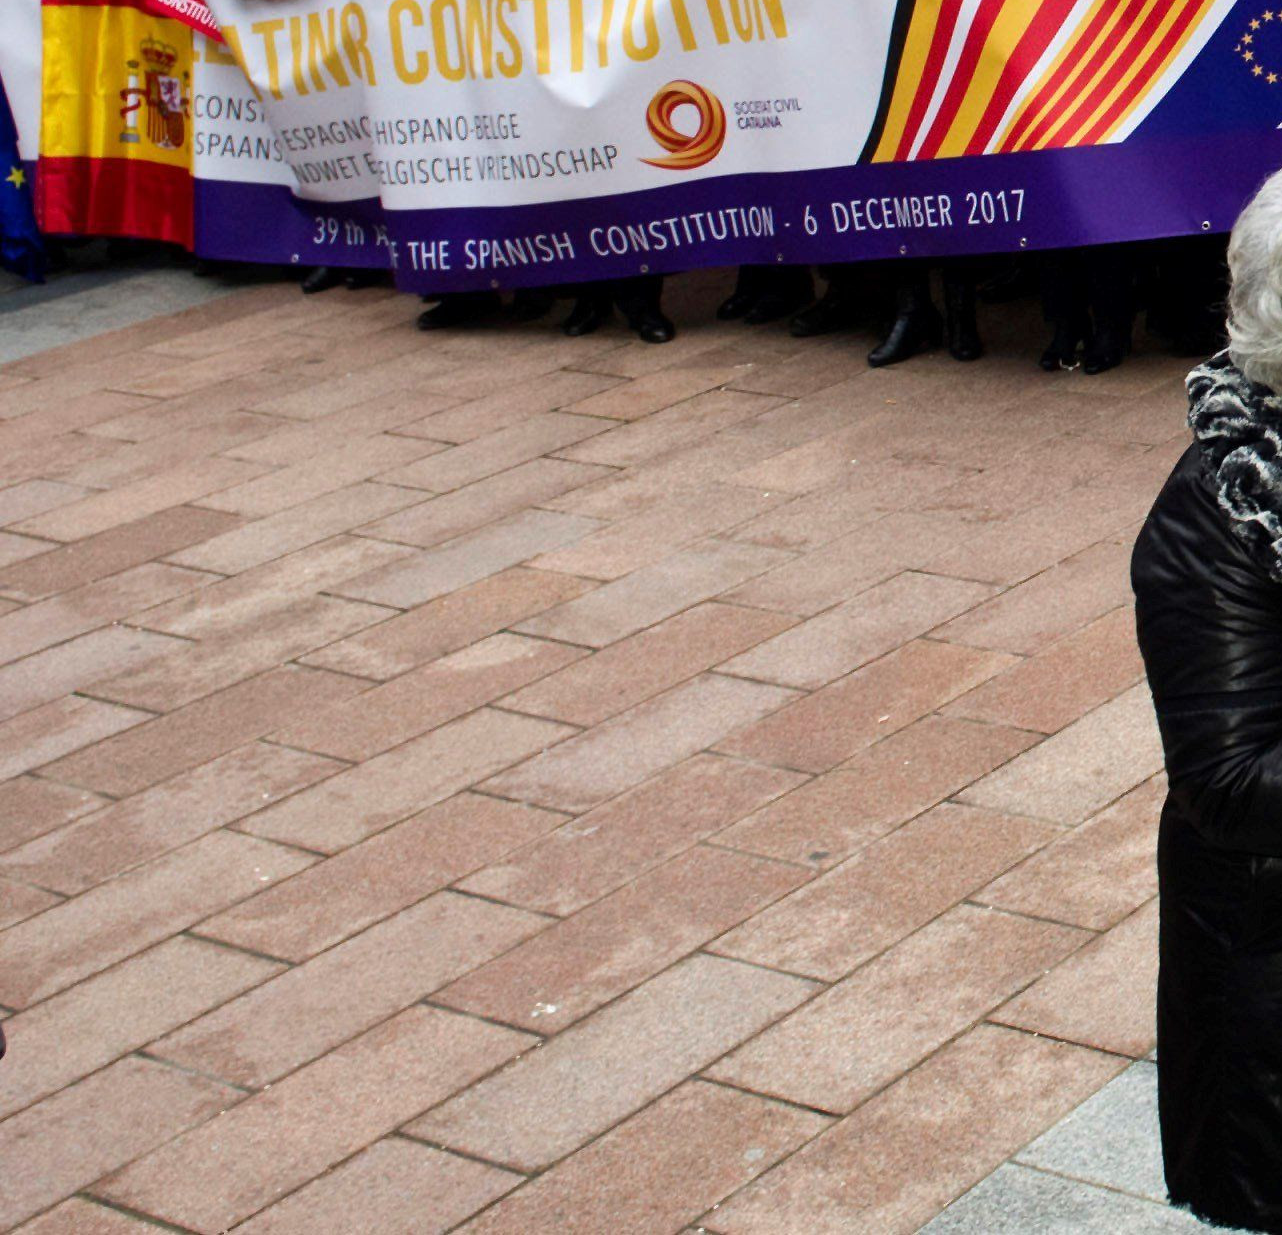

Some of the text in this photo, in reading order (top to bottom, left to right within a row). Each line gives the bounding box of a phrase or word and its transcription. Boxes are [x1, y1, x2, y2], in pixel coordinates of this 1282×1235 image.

[375, 114, 521, 145] HISPANO-BELGE
[475, 144, 618, 181] VRIENDSCHAP
[313, 217, 338, 244] 39
[407, 240, 450, 271] THE
[463, 232, 576, 271] SPANISH
[590, 206, 775, 257] CONSTITUTION
[803, 205, 818, 236] 6
[831, 194, 953, 233] DECEMBER
[966, 188, 1025, 225] 2017
